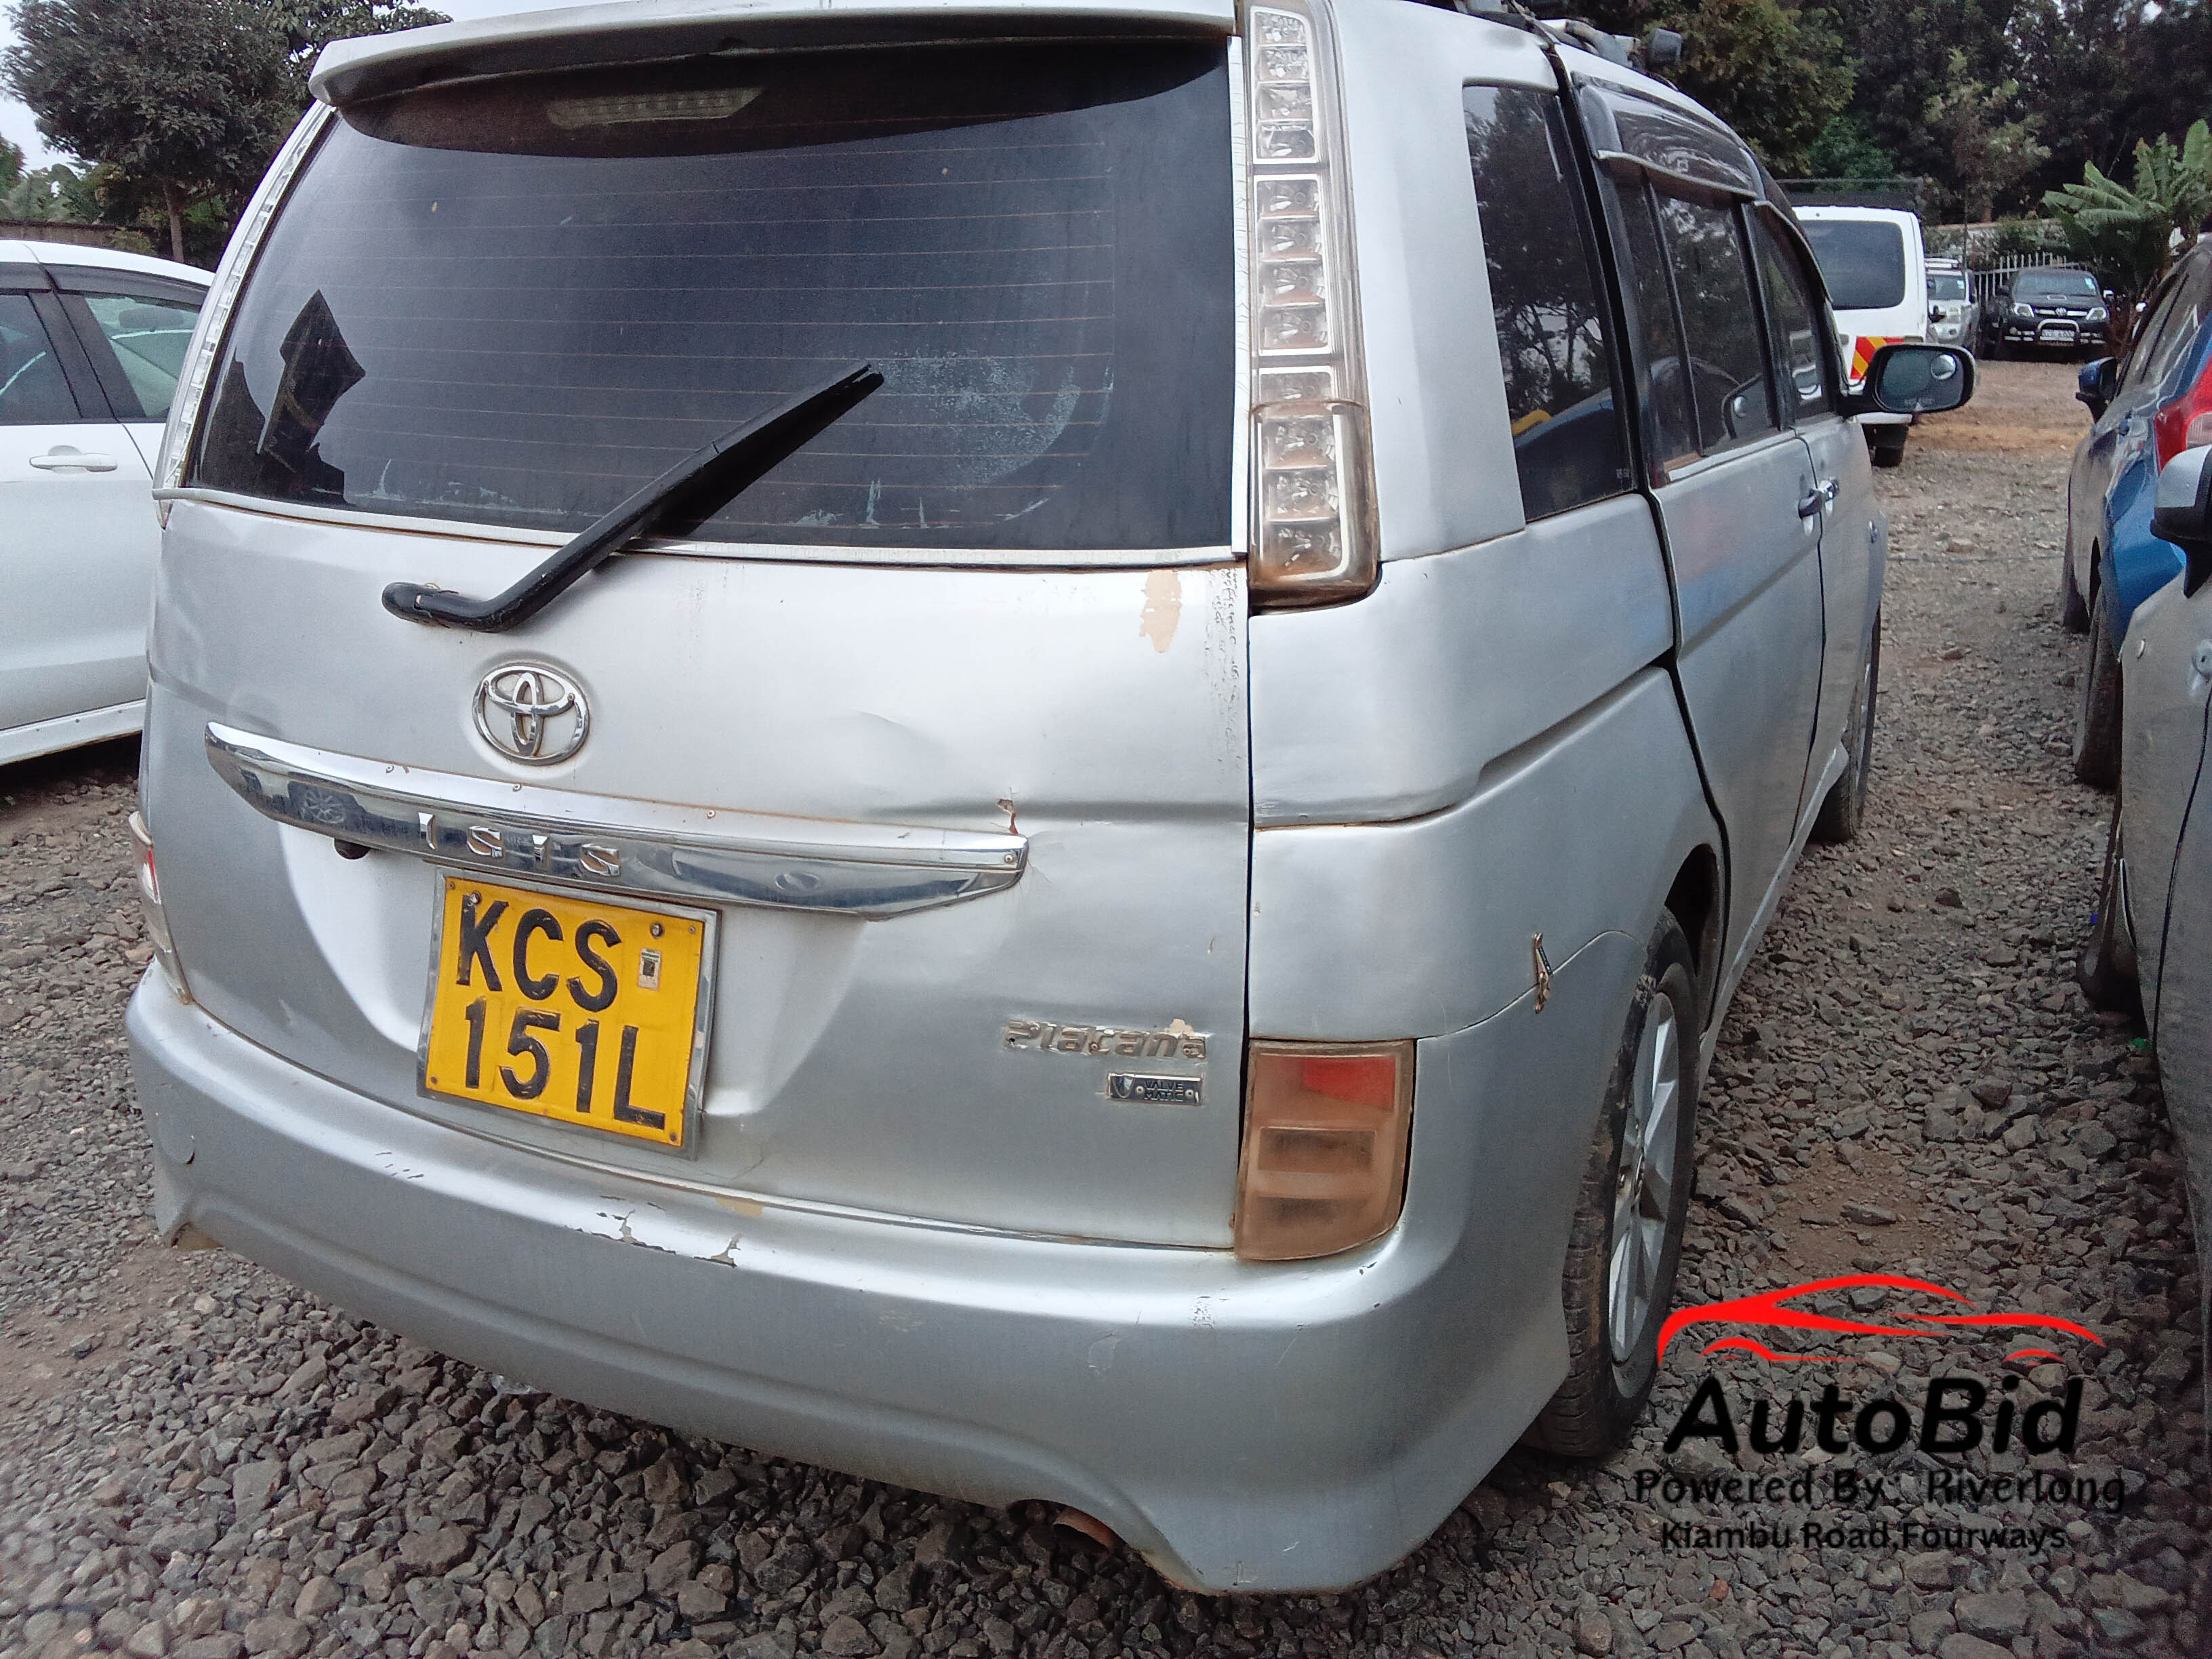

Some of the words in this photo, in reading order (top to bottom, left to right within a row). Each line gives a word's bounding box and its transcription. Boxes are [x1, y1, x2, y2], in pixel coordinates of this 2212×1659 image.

[417, 812, 621, 876] ISIS
[455, 894, 623, 1013] KCS
[465, 995, 665, 1130] 151L
